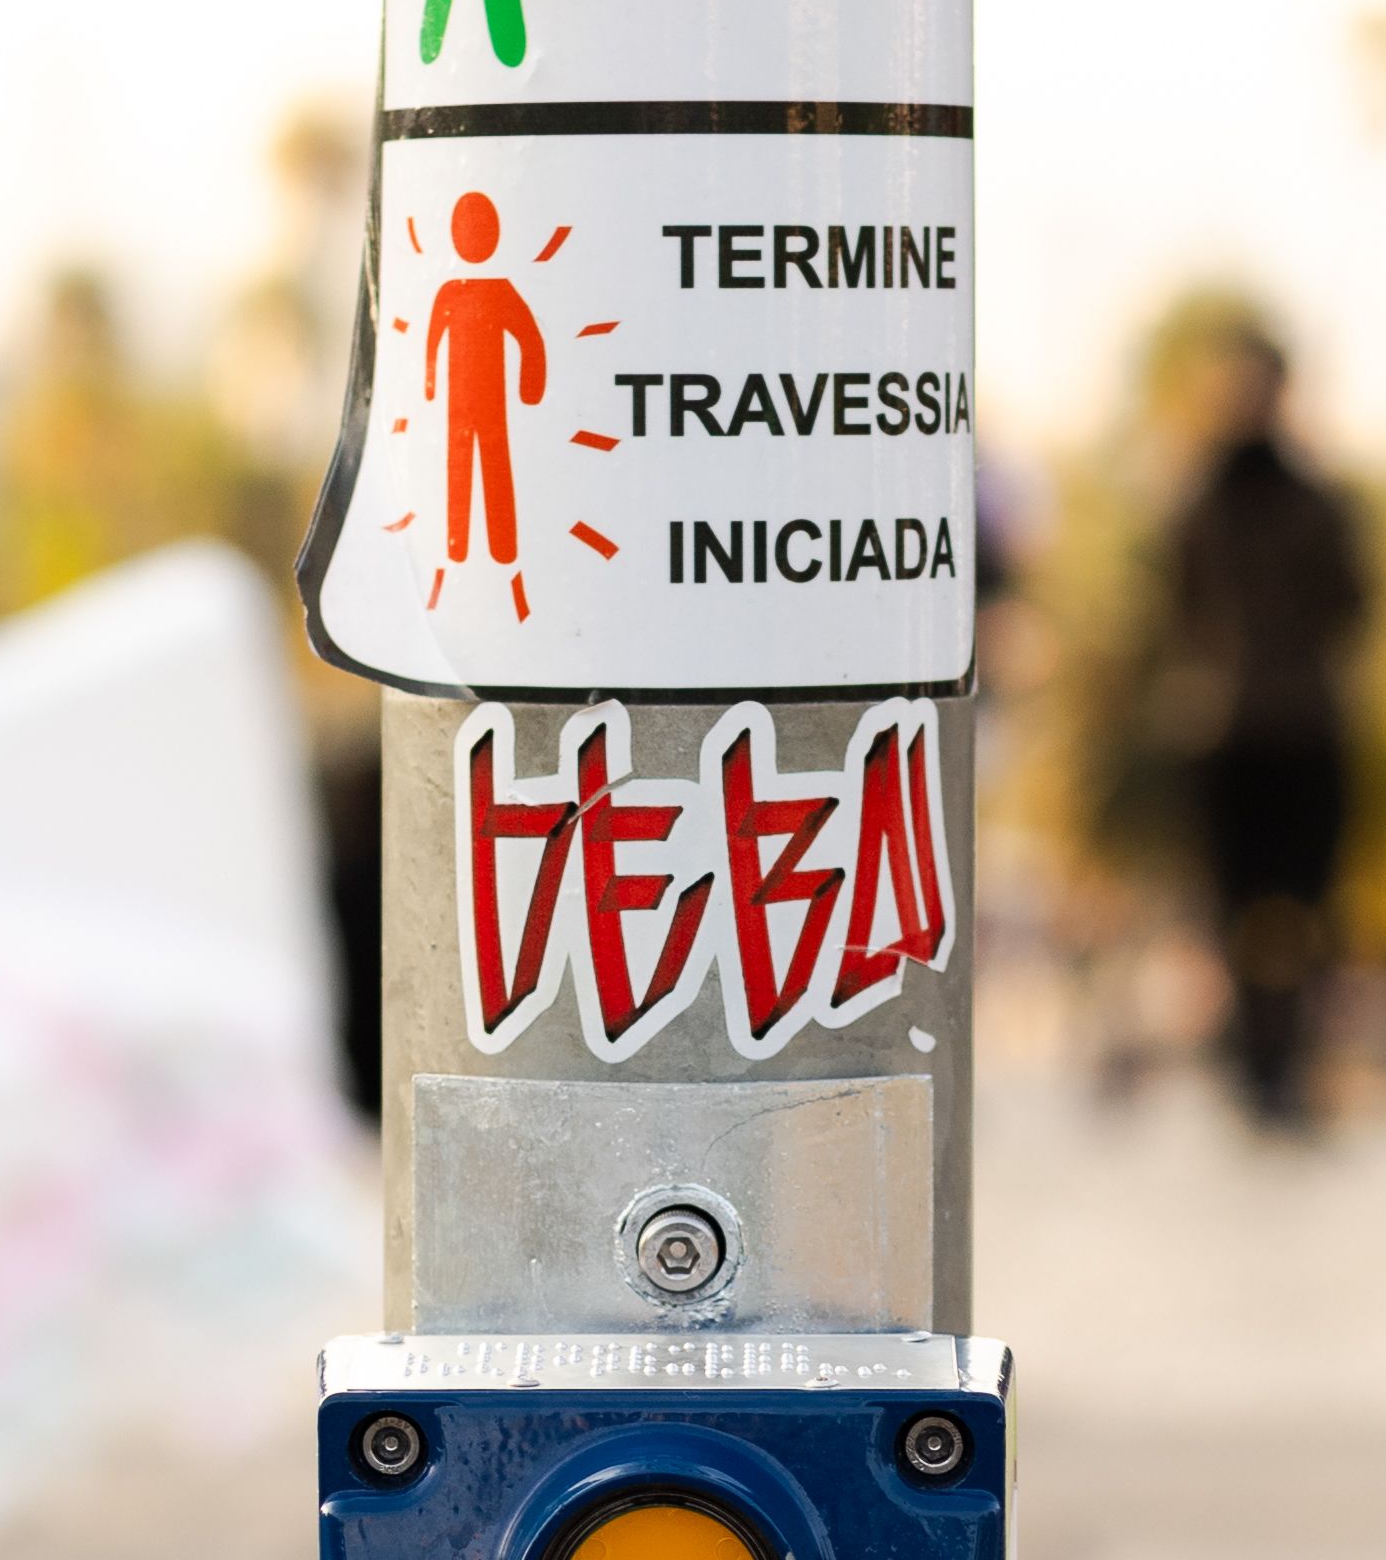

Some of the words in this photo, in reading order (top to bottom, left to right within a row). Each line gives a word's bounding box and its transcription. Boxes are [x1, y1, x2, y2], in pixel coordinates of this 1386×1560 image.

[663, 225, 956, 289] TERMINE
[614, 372, 971, 437] TRAVESSIA
[669, 517, 956, 584] INICIADA
